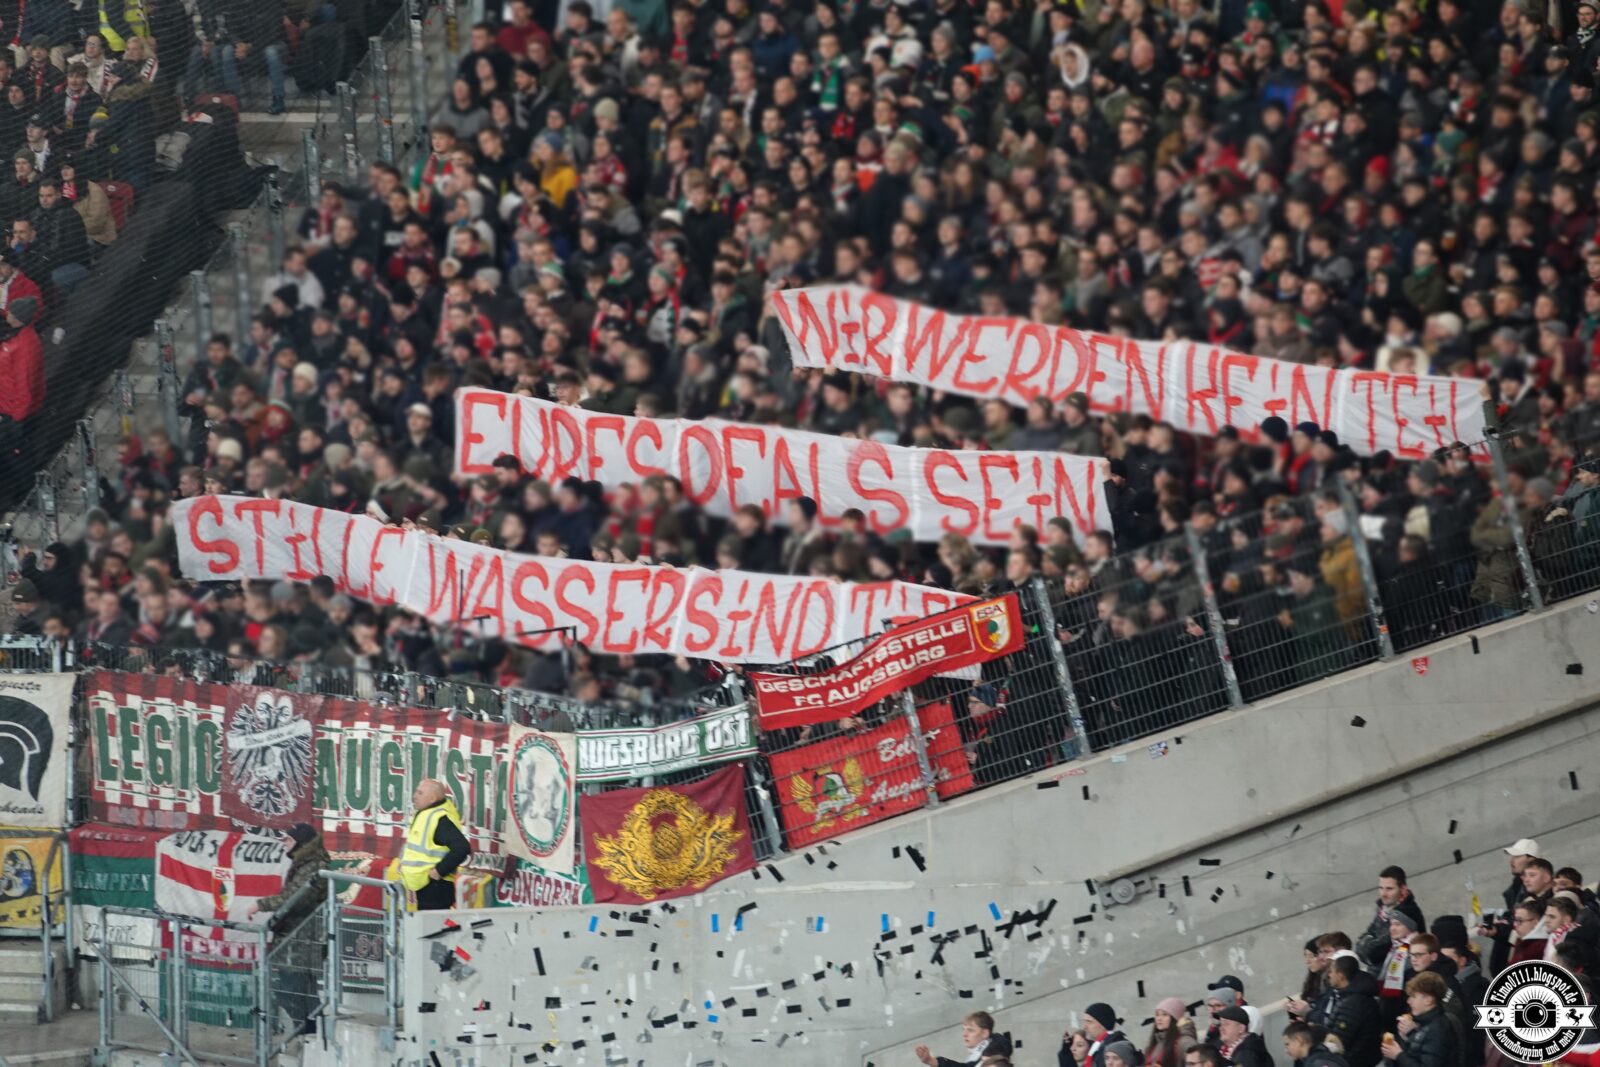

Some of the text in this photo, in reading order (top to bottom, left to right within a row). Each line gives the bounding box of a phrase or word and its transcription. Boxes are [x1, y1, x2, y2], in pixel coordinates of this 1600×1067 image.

[772, 289, 897, 377] WIR
[904, 303, 1166, 422] WERDEN
[1185, 343, 1336, 443] KEIN
[679, 425, 909, 536] DEALS
[923, 450, 1095, 544] SEIN
[188, 495, 404, 605] STILLE
[426, 543, 685, 652] WASSER
[684, 570, 834, 659] SIND
[827, 644, 946, 703] AUGSBURG
[95, 706, 222, 794] LEGIO
[705, 711, 751, 752] OST
